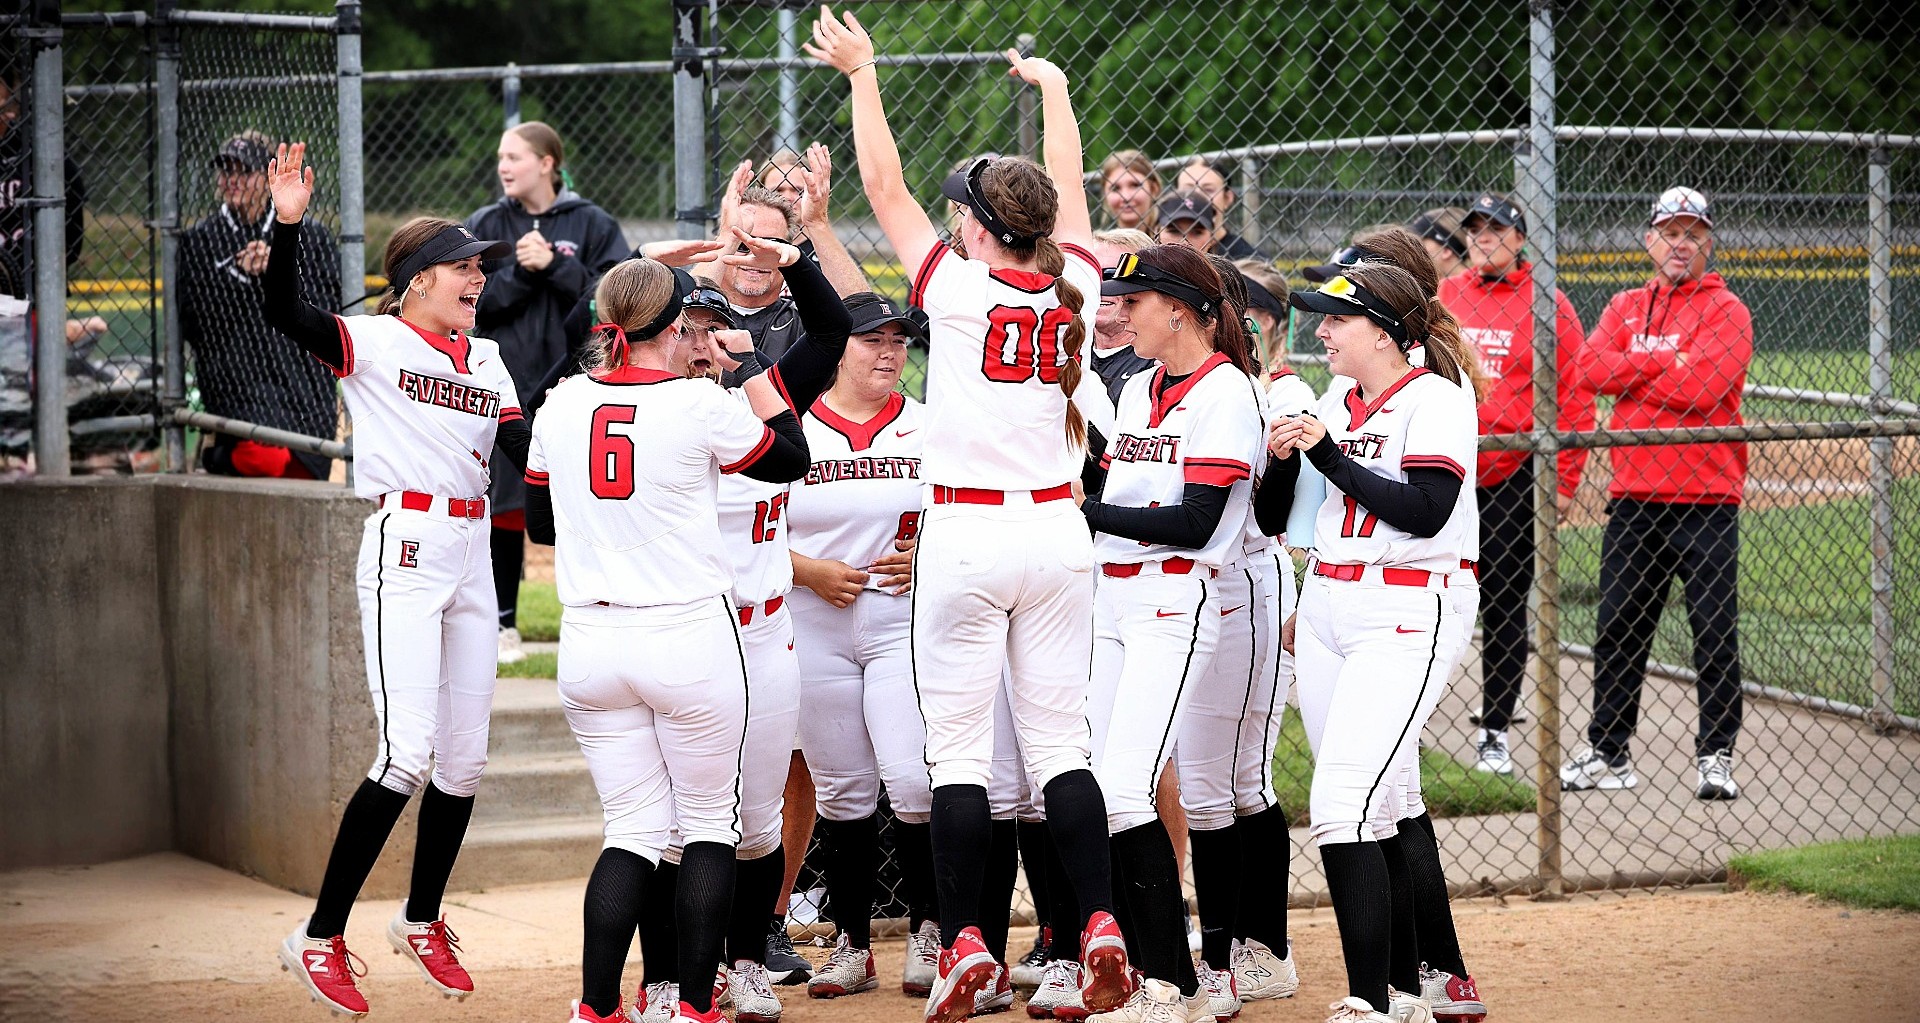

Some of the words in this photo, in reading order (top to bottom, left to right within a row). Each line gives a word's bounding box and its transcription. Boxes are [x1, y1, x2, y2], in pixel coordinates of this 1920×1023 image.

[981, 304, 1083, 384] 00
[398, 368, 501, 419] EVERETT
[589, 404, 637, 500] 6
[804, 457, 921, 486] EVERETT
[399, 540, 419, 568] E
